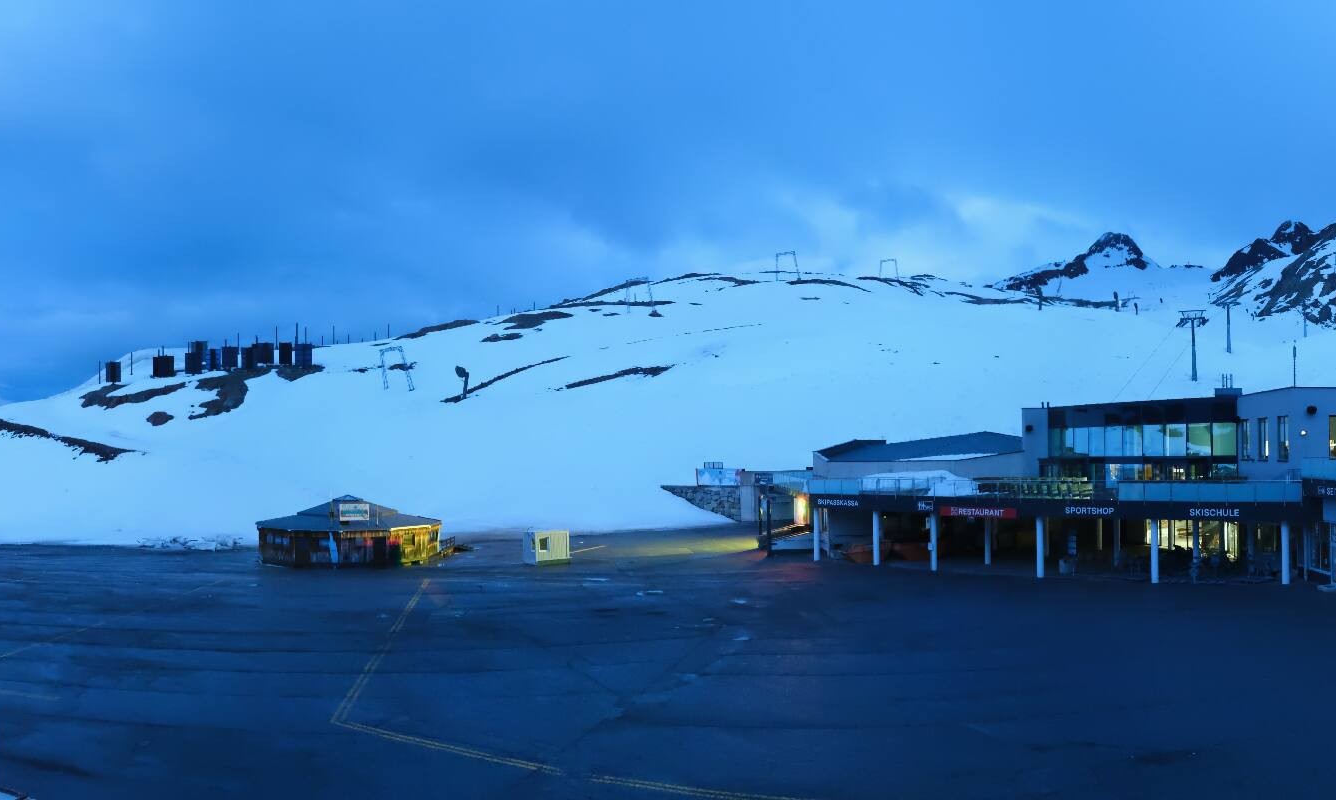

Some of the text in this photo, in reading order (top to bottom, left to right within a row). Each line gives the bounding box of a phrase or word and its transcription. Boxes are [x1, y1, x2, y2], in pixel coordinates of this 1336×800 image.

[817, 498, 859, 507] SKIPASSKASSA
[958, 508, 1005, 517] RESTAURANT
[1064, 506, 1115, 515] SPORTSHOP
[1189, 508, 1240, 517] SKISCHULE
